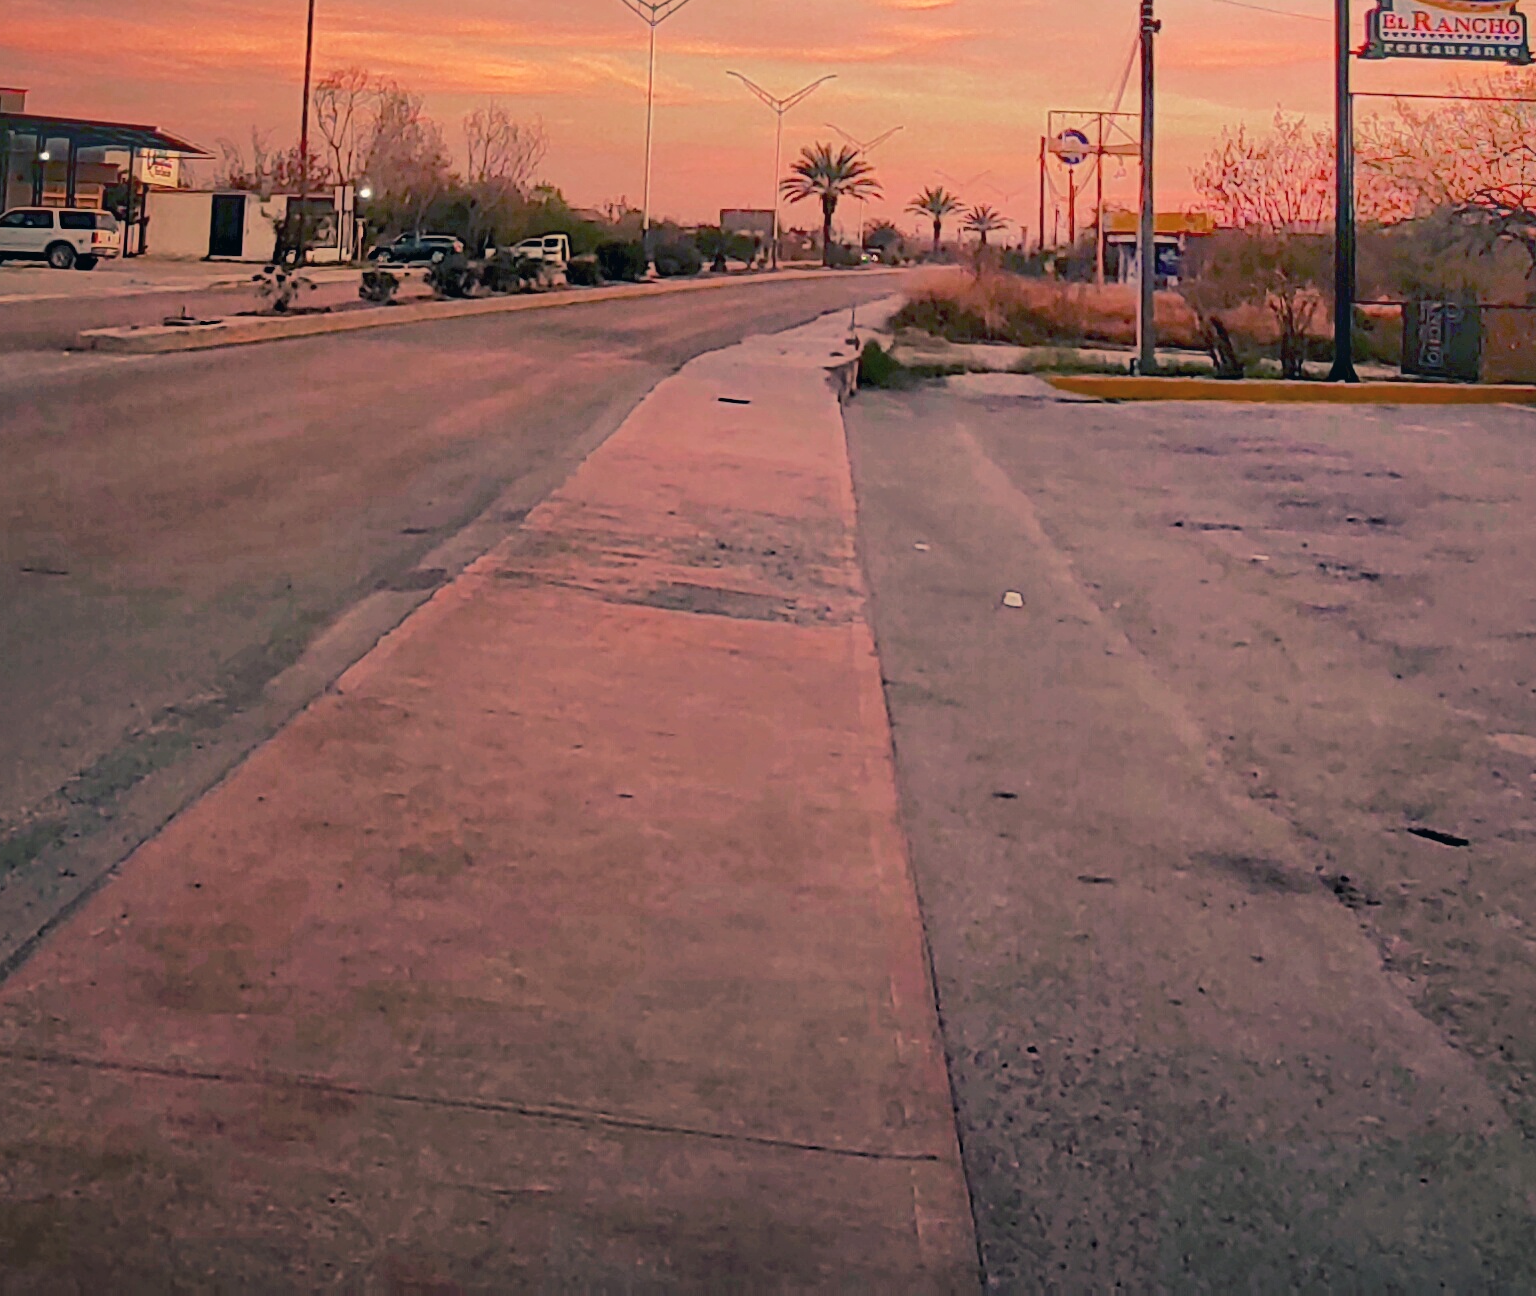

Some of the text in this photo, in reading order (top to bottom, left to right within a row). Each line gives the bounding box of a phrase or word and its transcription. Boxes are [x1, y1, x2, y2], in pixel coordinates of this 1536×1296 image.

[1383, 10, 1520, 34] EL RANCHO
[1383, 43, 1520, 57] restaurante
